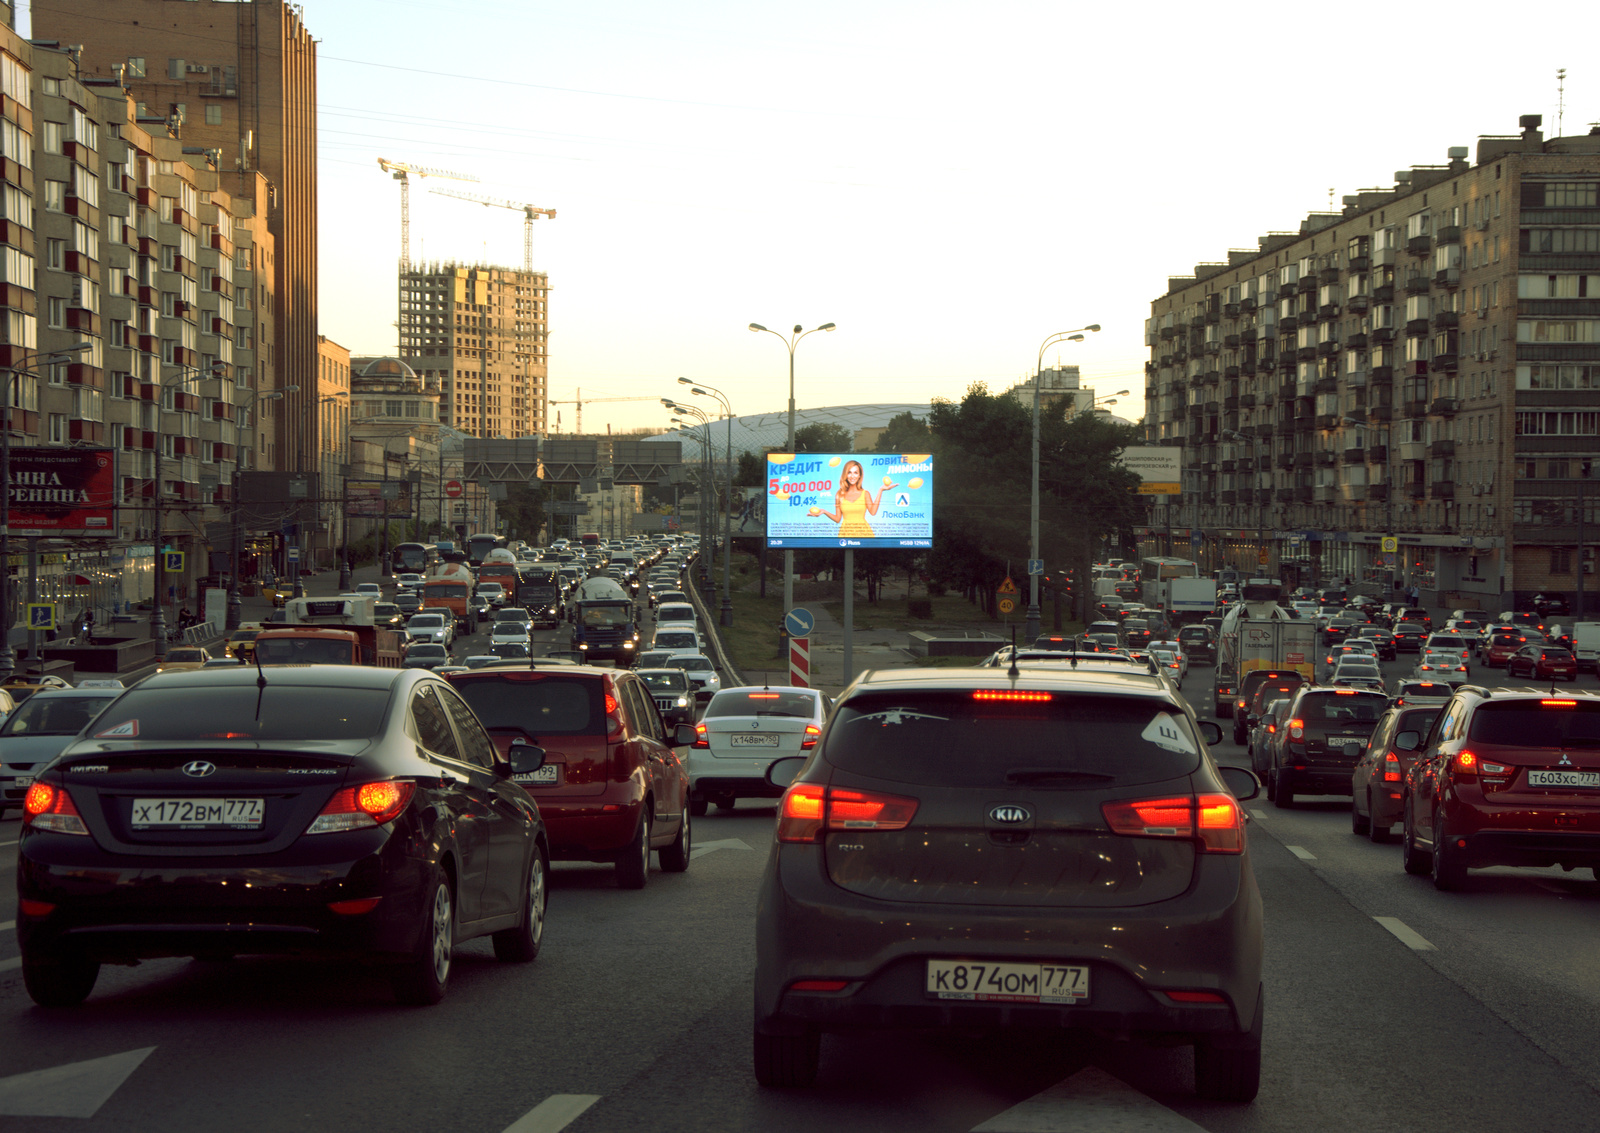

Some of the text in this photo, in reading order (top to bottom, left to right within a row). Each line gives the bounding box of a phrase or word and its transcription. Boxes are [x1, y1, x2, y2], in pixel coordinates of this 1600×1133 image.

[871, 456, 908, 466] ЛОВИТЕ
[770, 461, 823, 475] КРЕДИТ
[887, 463, 933, 474] ЛИМОНЫ
[769, 478, 832, 495] 5 000 000
[788, 495, 817, 507] 10,4%
[882, 511, 925, 519] ЛокоБанк
[1159, 726, 1178, 741] Ш
[733, 736, 764, 744] Х148ВМ
[538, 767, 553, 776] 199
[1532, 772, 1597, 784] Т603ХС 777
[139, 800, 258, 821] Х172ВМ 777
[996, 808, 1024, 822] KIA
[838, 844, 865, 852] RIO
[936, 965, 1082, 993] К874ОМ 777
[1051, 987, 1071, 996] RUS
